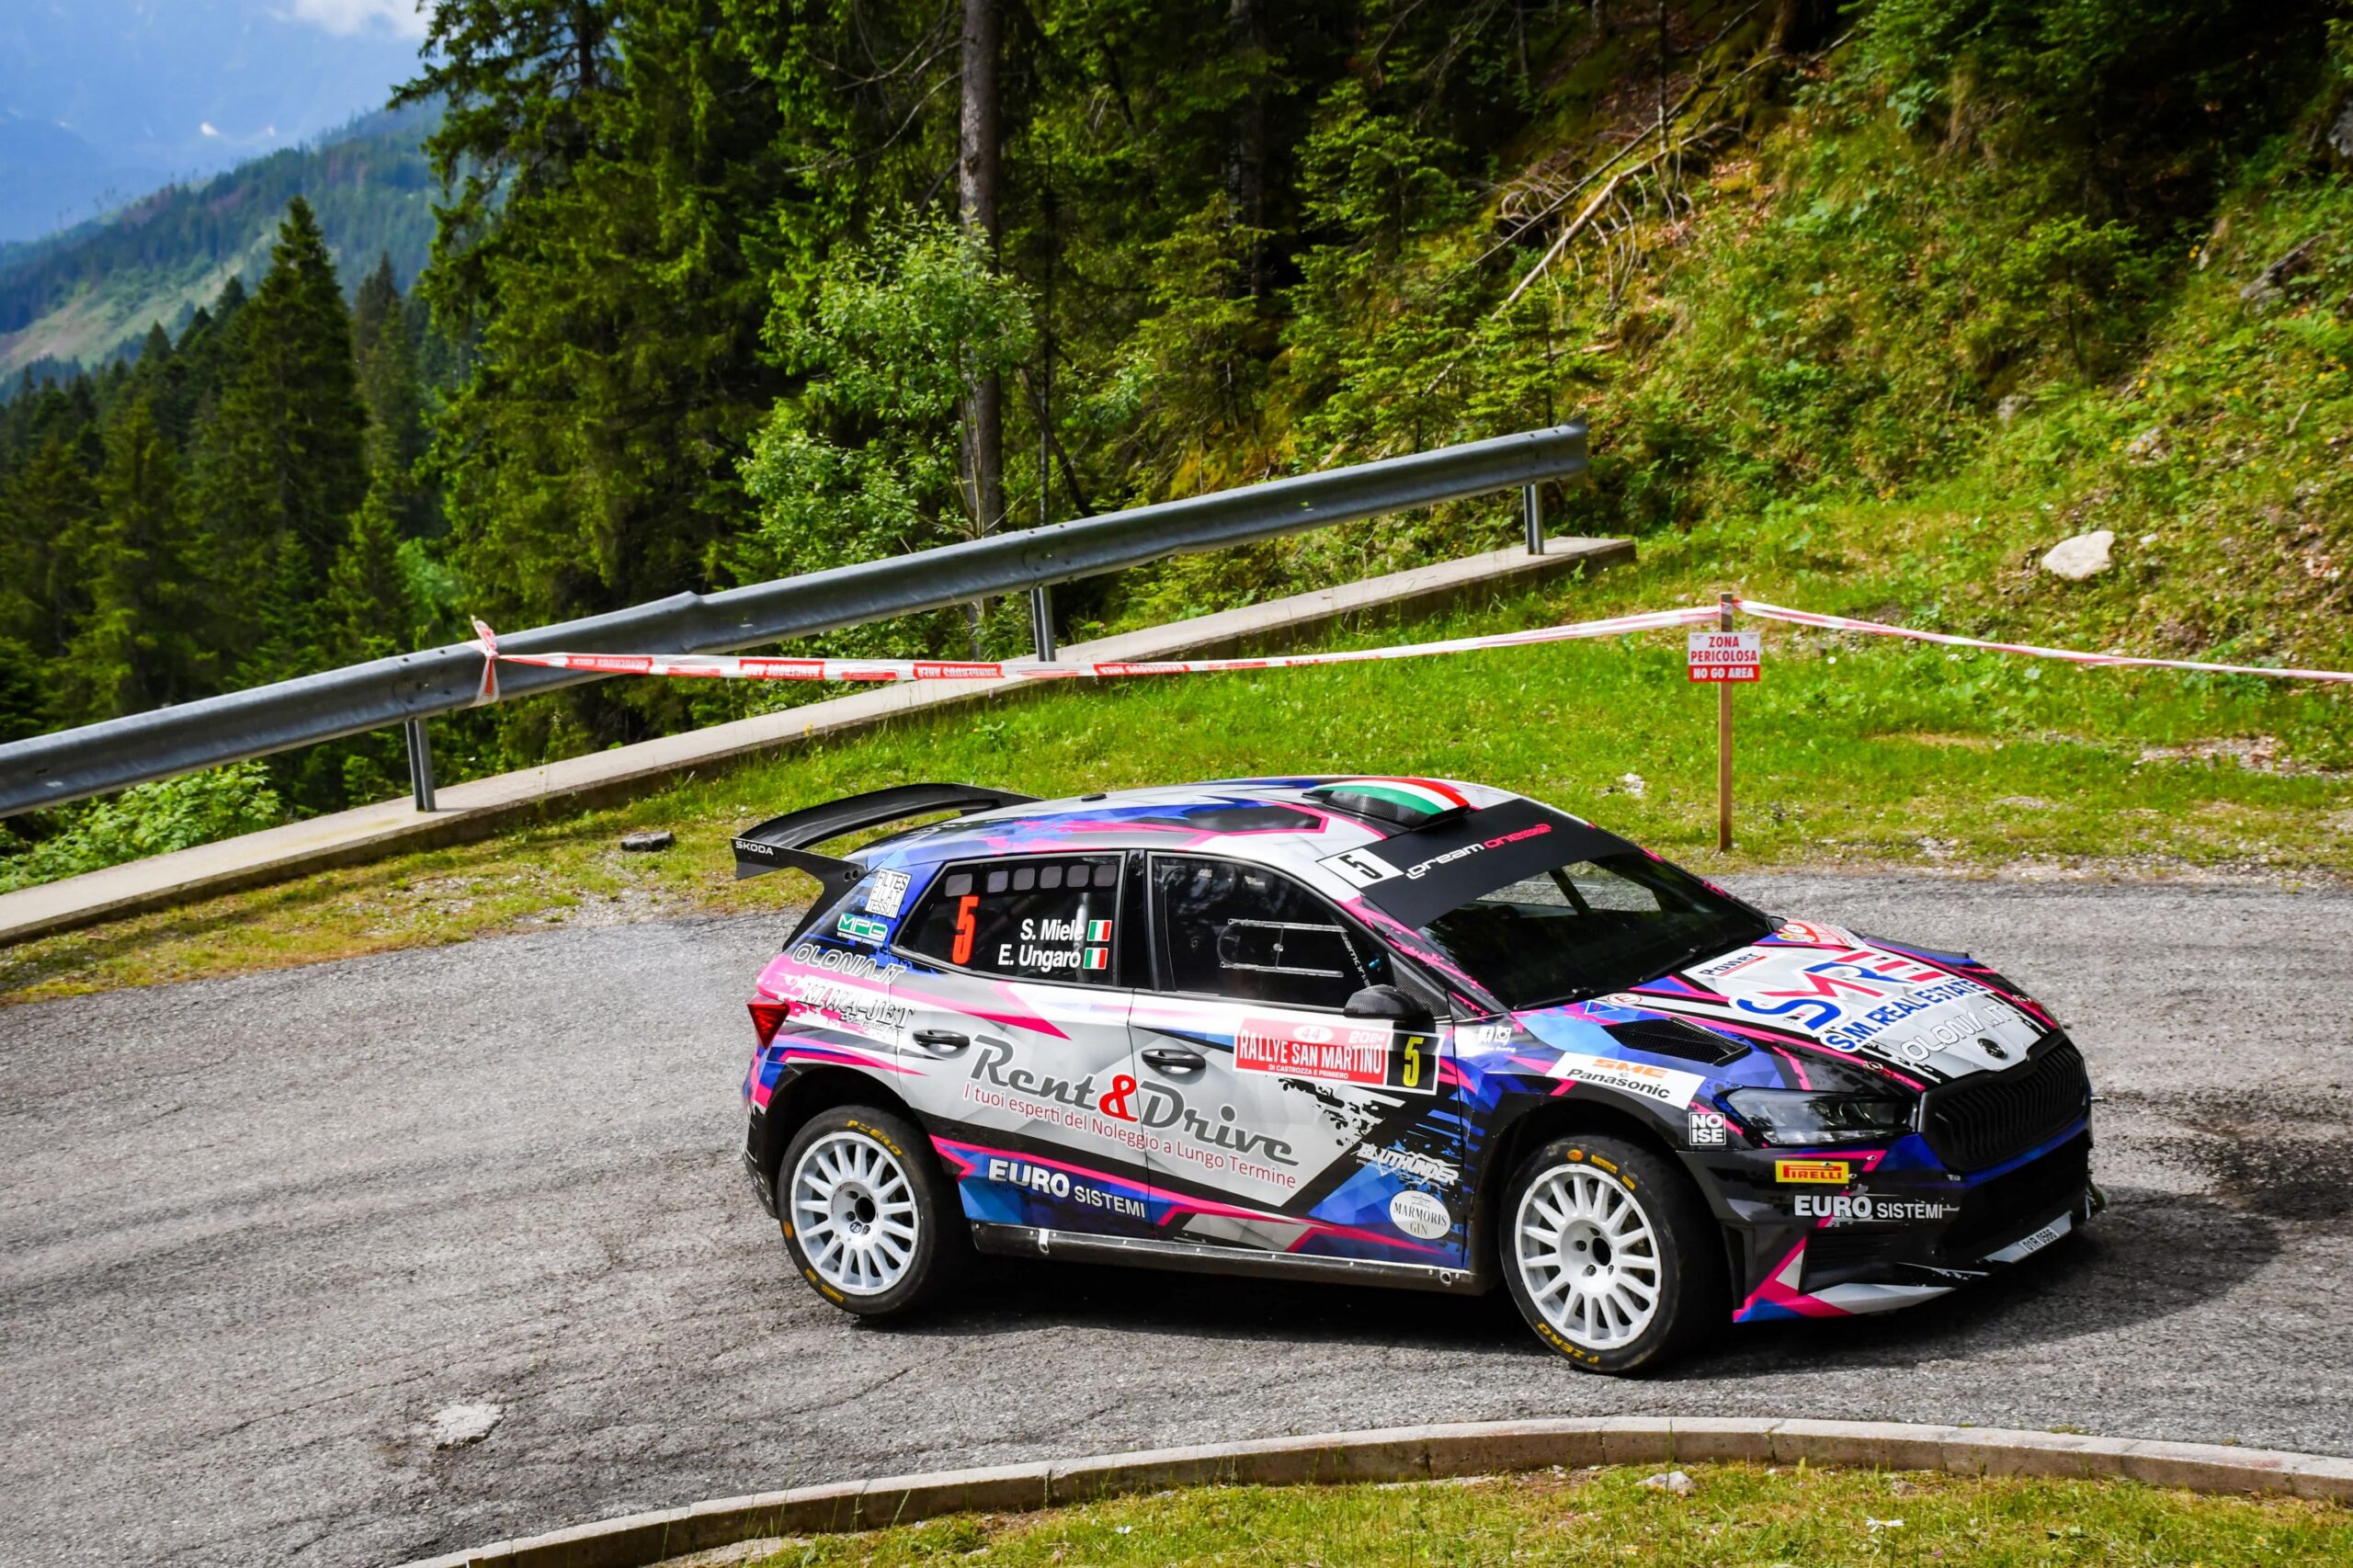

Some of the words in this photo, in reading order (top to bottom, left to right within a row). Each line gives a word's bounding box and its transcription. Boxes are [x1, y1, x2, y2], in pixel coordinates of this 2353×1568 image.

[1709, 635, 1739, 648] ZONA
[1691, 650, 1757, 662] PERICOLOSA
[1693, 668, 1708, 678] NO
[1711, 668, 1725, 678] GO
[1728, 667, 1755, 678] AREA
[1338, 854, 1383, 880] 5
[878, 871, 909, 891] FILTES
[952, 895, 980, 965] 5
[1020, 918, 1036, 941] S.
[1040, 919, 1085, 941] Miele
[998, 944, 1014, 965] E.
[1018, 945, 1081, 972] Ungaro
[1915, 980, 1986, 1004] ESTATE
[1347, 1030, 1385, 1044] 2024
[1240, 1029, 1289, 1064] RALLYE
[1291, 1043, 1318, 1068] SAN
[1321, 1045, 1383, 1074] MARTINO
[1403, 1036, 1425, 1087] 5
[1276, 1064, 1313, 1076] CASTROZZA
[1319, 1069, 1349, 1080] PRIMIERO
[1566, 1069, 1670, 1098] Panasonic
[1691, 1114, 1723, 1129] NO
[965, 1083, 970, 1098] I
[975, 1086, 1004, 1108] tuoi
[1009, 1097, 1060, 1122] esperti
[1065, 1111, 1086, 1131] del
[1092, 1119, 1159, 1150] Noleggio
[1164, 1142, 1171, 1153] a
[1177, 1141, 1224, 1168] Lungo
[1230, 1155, 1296, 1187] Termine
[1691, 1129, 1724, 1143] ISE
[1783, 1165, 1843, 1180] PIRELLI
[989, 1158, 1070, 1198] EURO
[1074, 1186, 1145, 1218] SISTEMI
[1393, 1201, 1448, 1227] MARMORIS
[1794, 1195, 1873, 1218] EURO
[1877, 1203, 1943, 1219] SISTEMI
[1410, 1221, 1427, 1235] GIN
